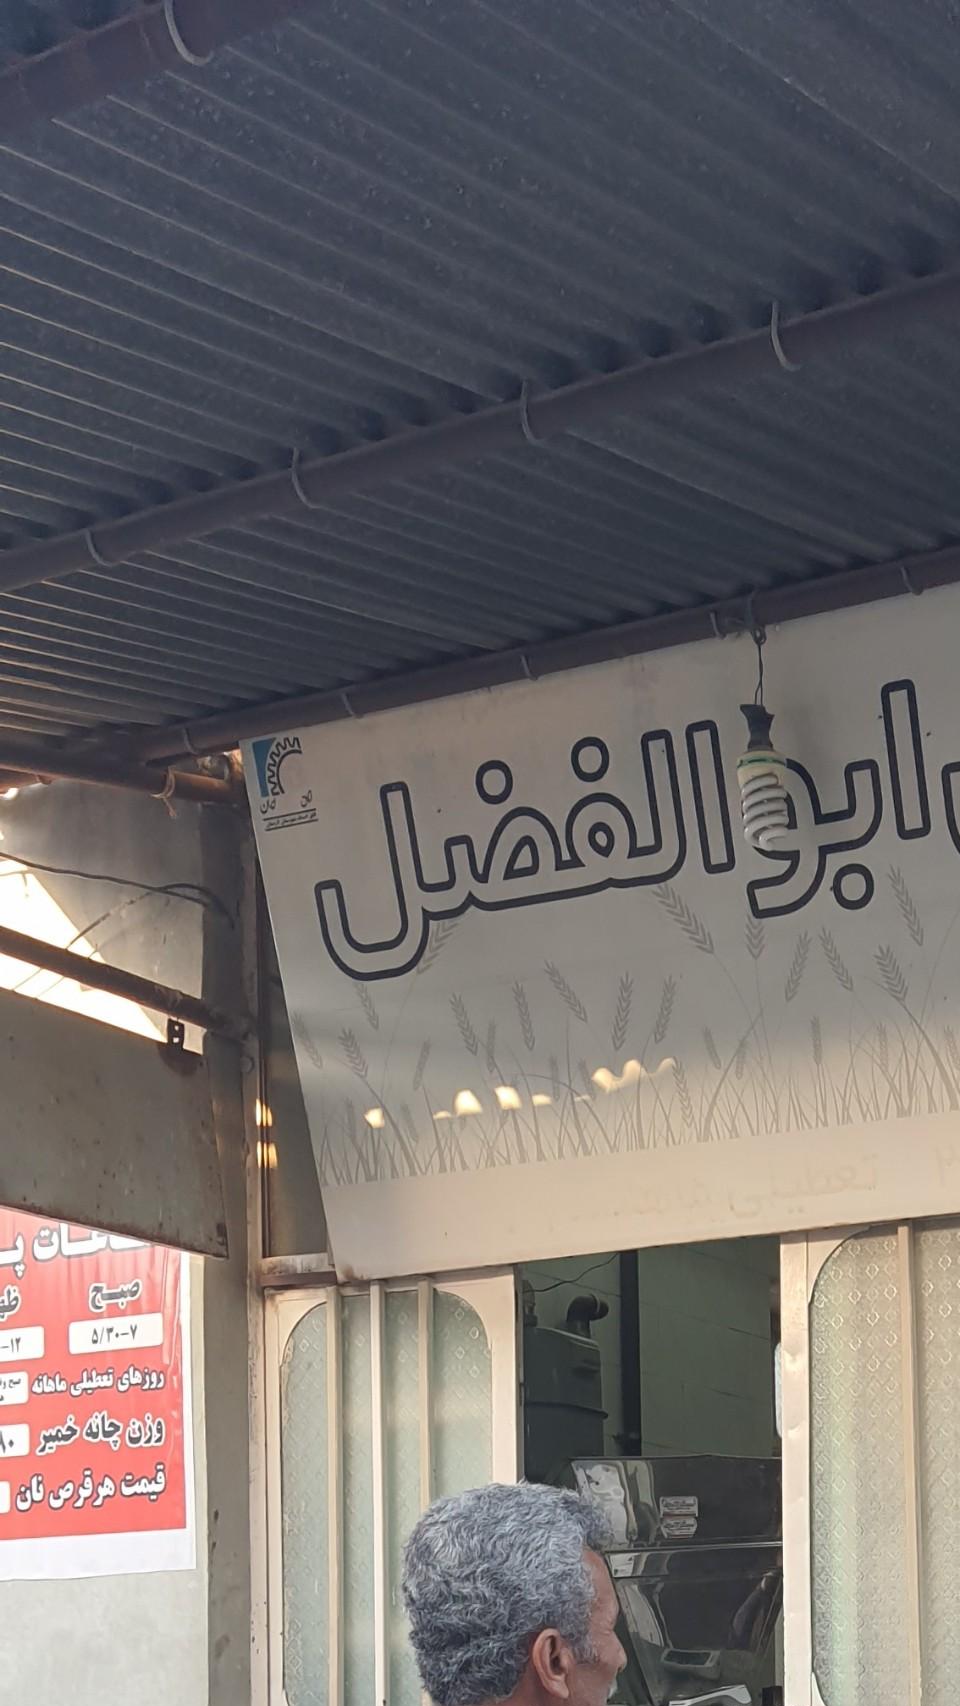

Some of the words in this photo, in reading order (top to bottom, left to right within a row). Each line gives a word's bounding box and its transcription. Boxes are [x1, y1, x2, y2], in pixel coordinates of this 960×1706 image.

[315, 679, 932, 981] ابوالفضل
[89, 1279, 142, 1311] صبح
[31, 1373, 67, 1395] ماهانه
[70, 1368, 114, 1396] تعطیلی
[116, 1365, 165, 1391] روزهای
[37, 1416, 79, 1454] خمیر
[84, 1411, 122, 1449] چانه
[127, 1413, 164, 1447] وزن
[15, 1473, 45, 1510] نان
[120, 1463, 166, 1501] قیمت
